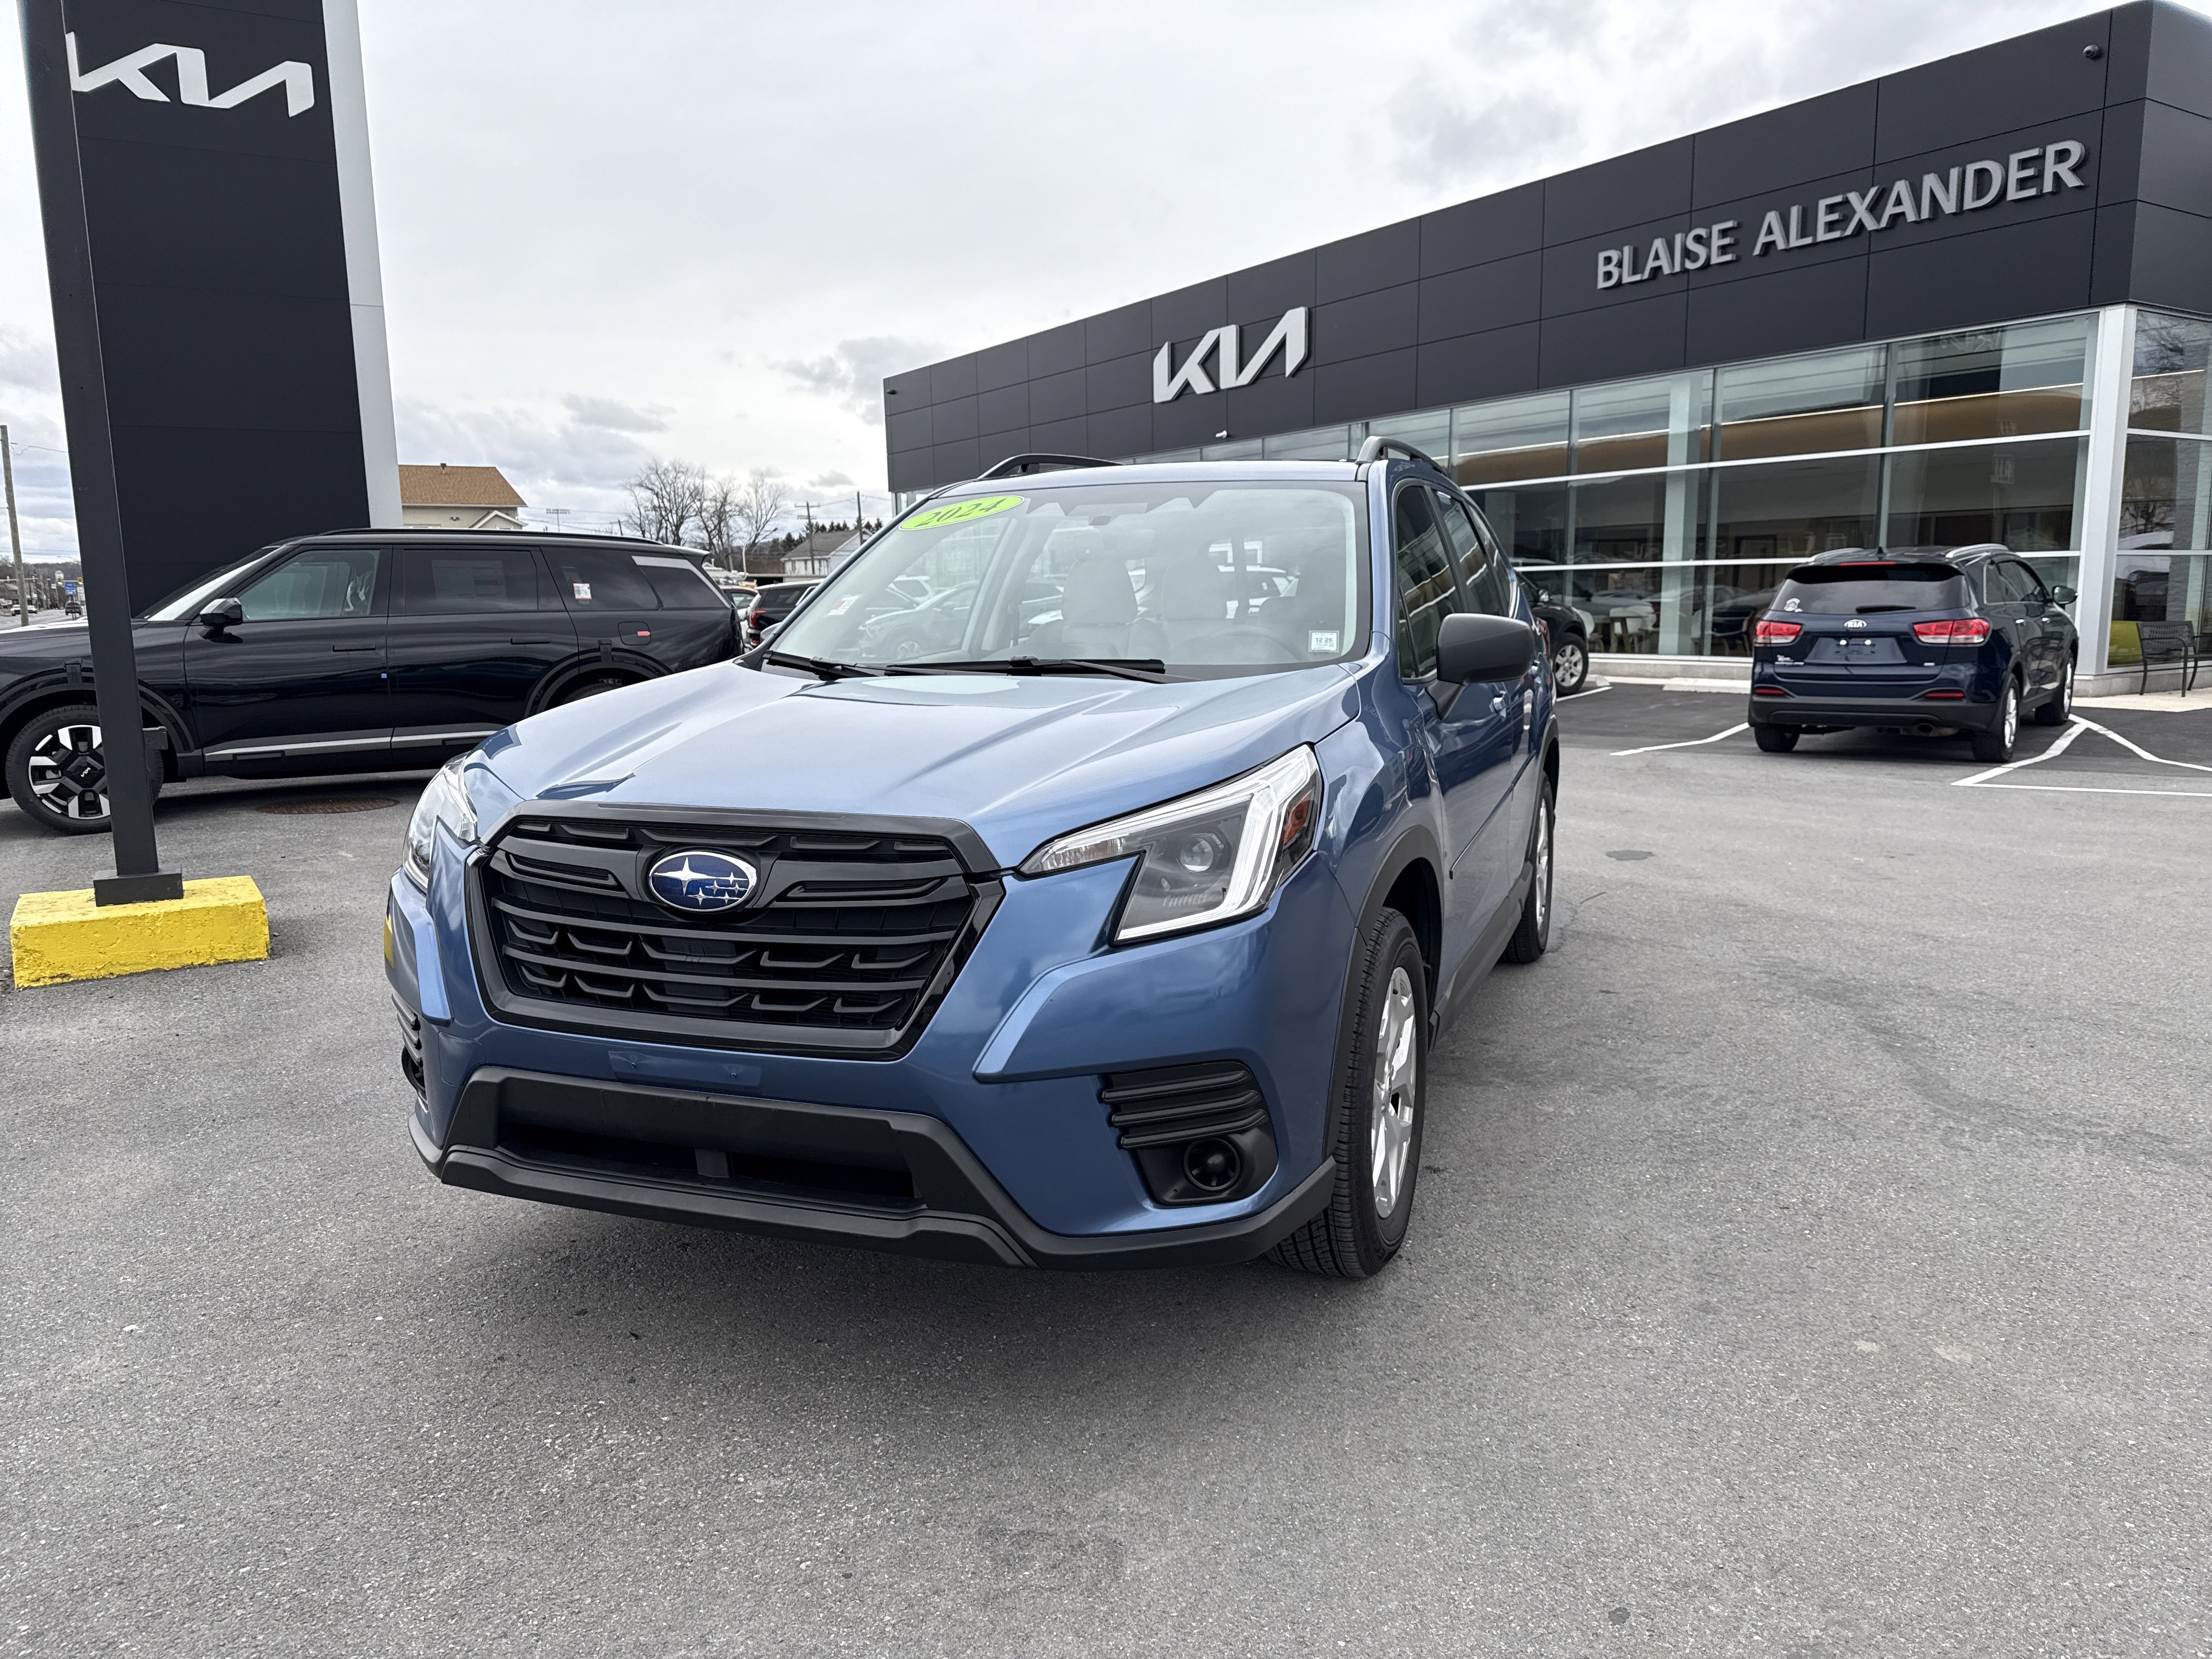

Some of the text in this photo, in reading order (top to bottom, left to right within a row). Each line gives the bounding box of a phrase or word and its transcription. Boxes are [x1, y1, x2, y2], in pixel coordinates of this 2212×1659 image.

[65, 31, 314, 117] KIA
[1597, 139, 2085, 289] BLAISE ALEXANDER
[1153, 306, 1309, 403] KIA
[913, 498, 1007, 527] 2024
